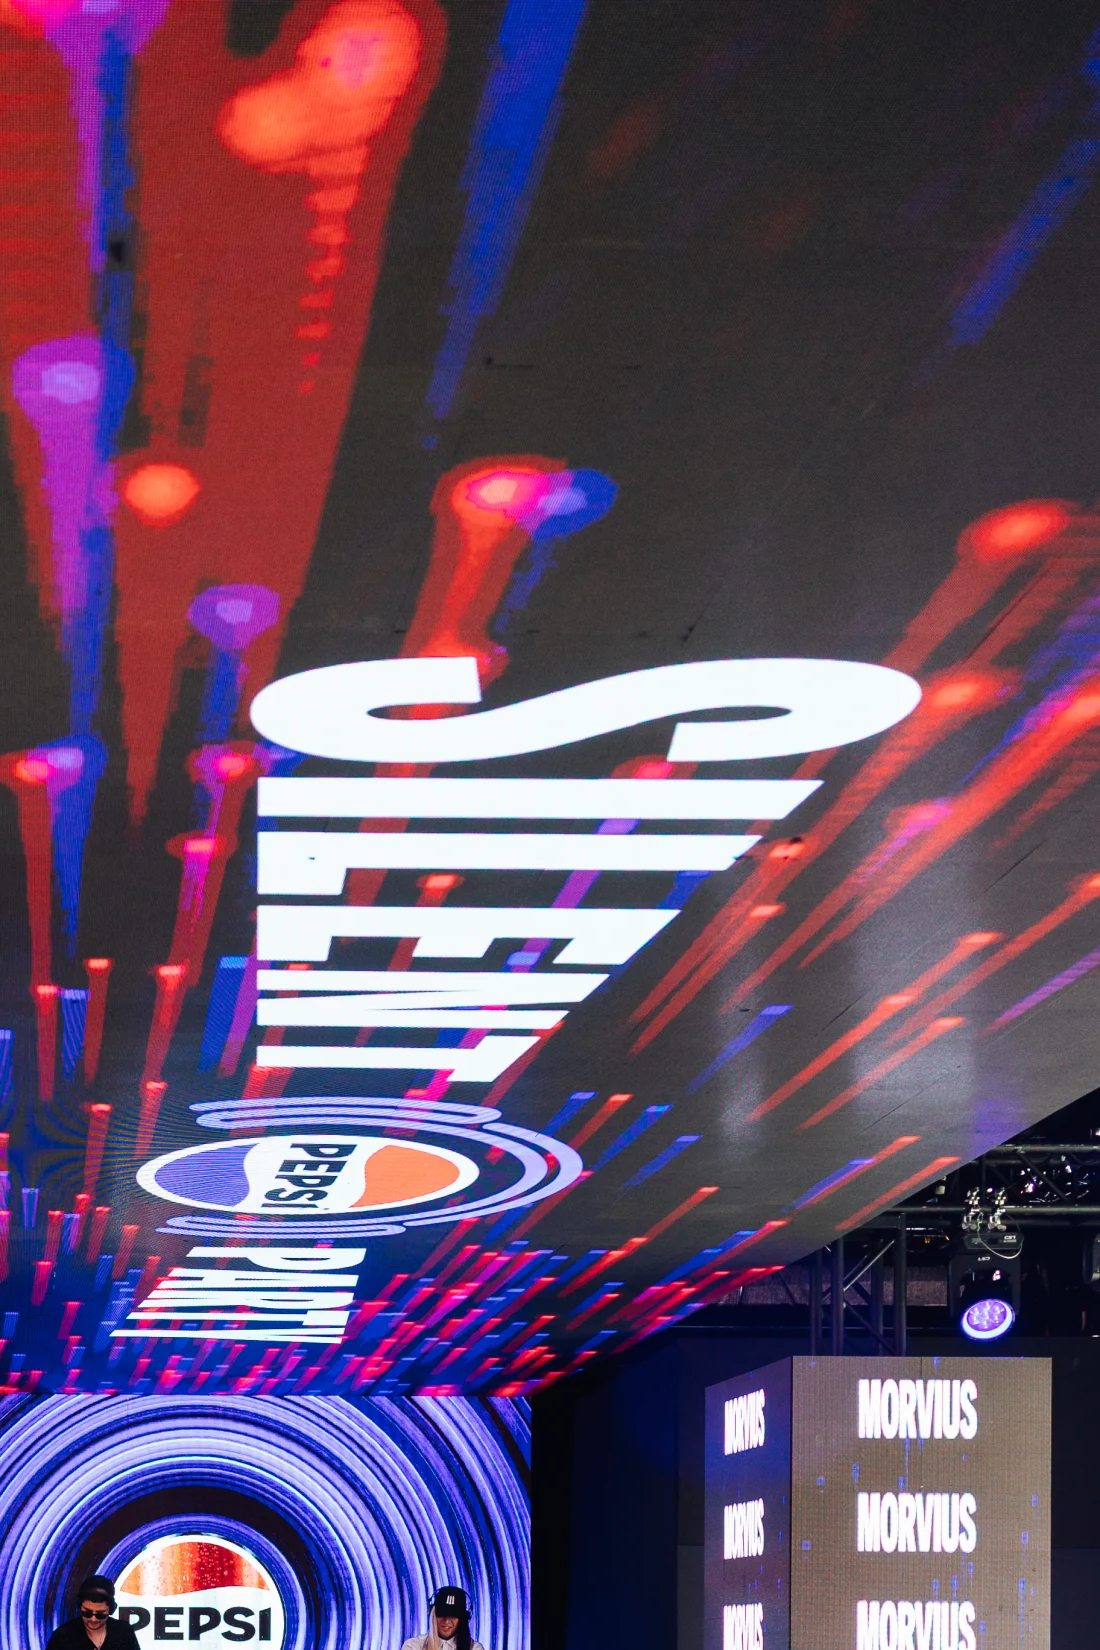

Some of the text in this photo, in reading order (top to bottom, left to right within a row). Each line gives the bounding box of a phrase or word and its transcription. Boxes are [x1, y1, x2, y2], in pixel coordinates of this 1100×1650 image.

[109, 657, 922, 1344] SILENT PEPSI PARTY
[724, 1389, 766, 1456] MORVIUS
[858, 1379, 978, 1440] MORVIUS
[723, 1498, 765, 1560] MORVIUS
[857, 1492, 977, 1553] MORVIUS
[118, 1606, 272, 1642] PEPSI
